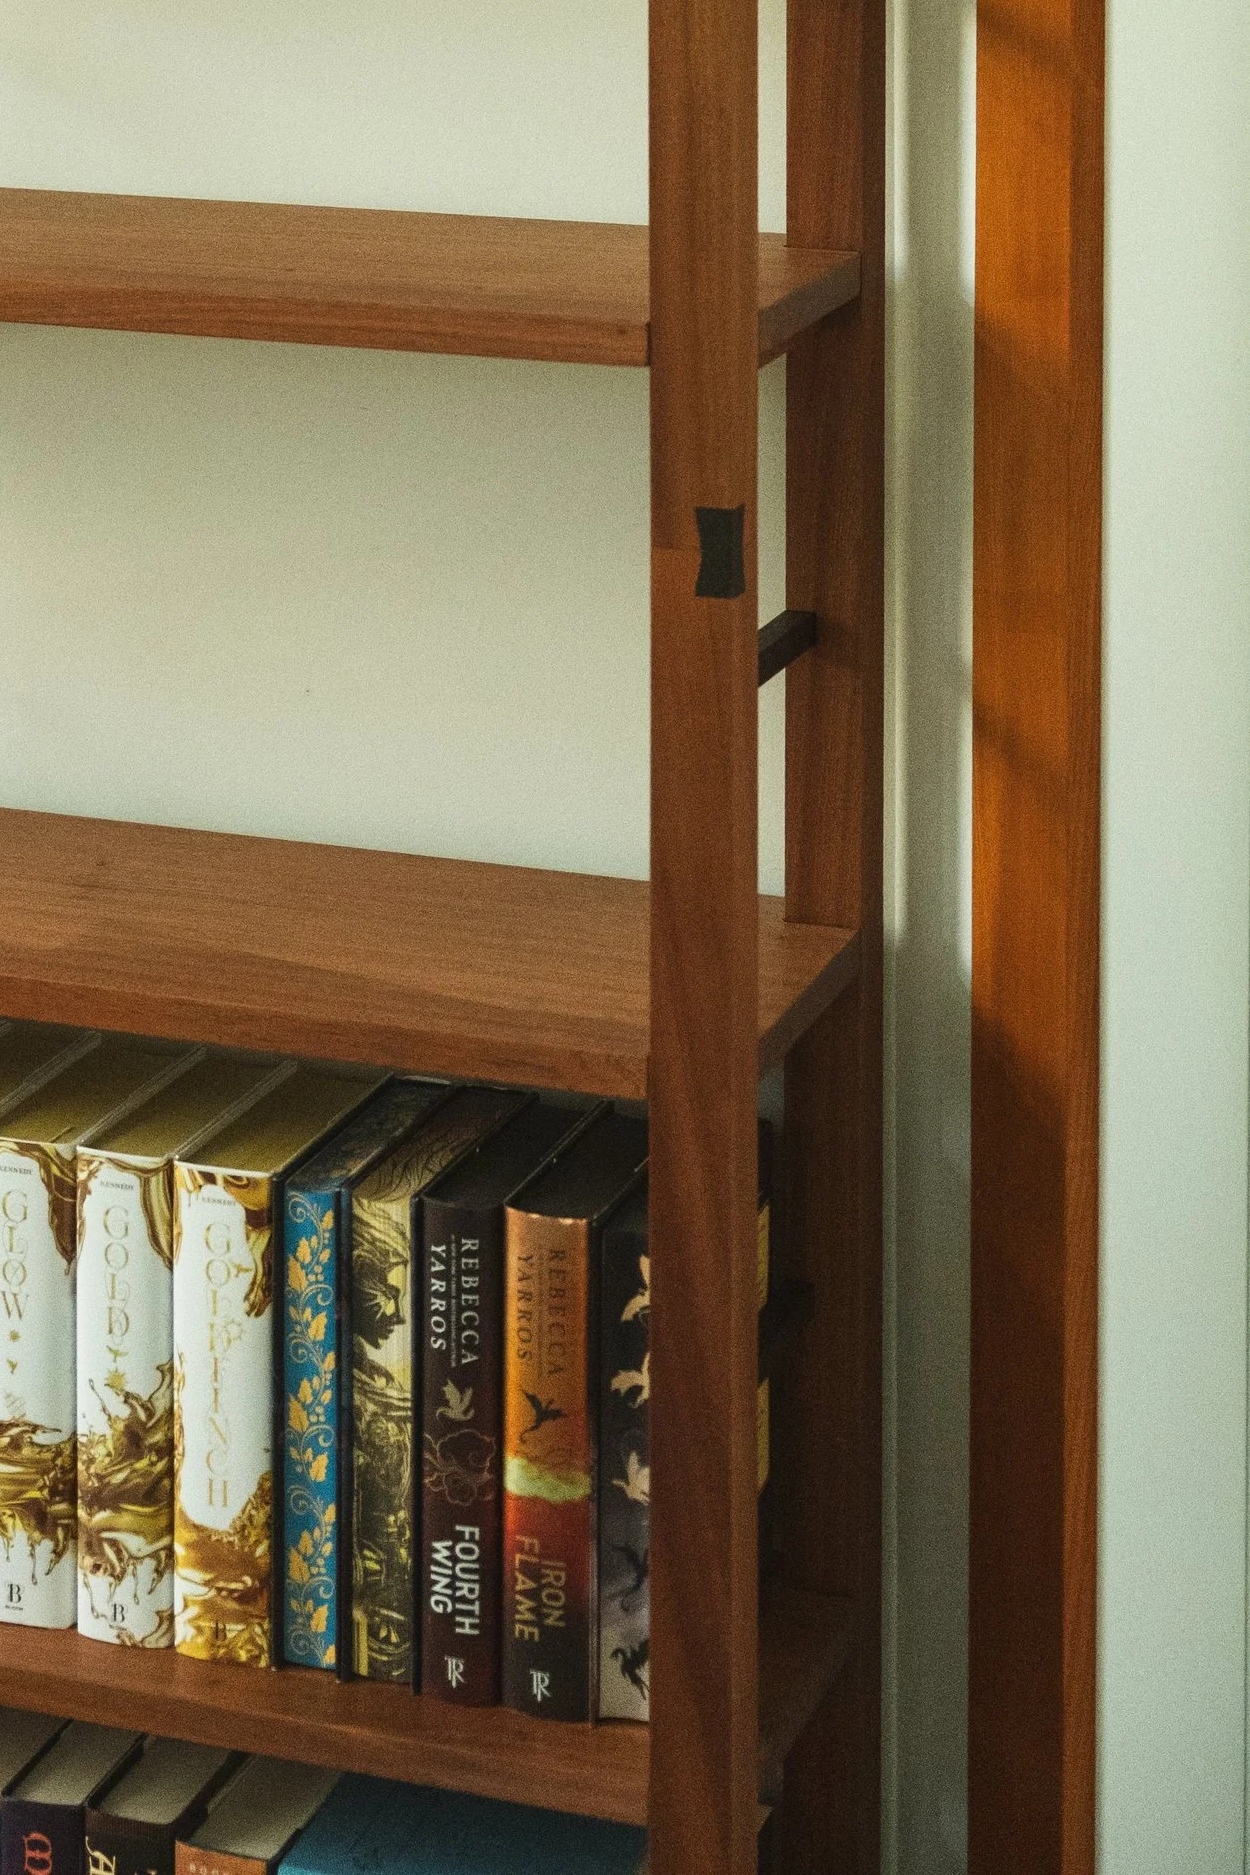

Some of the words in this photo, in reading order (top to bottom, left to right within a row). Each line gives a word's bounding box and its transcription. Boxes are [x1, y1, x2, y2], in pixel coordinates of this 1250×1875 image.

[0, 1189, 29, 1319] GLOW
[104, 1205, 131, 1337] GOLD
[430, 1244, 447, 1351] YARROS
[460, 1237, 479, 1365] REBECCA
[430, 1540, 453, 1615] WING
[455, 1525, 480, 1636] FOURTH
[514, 1535, 539, 1642] FLAME
[541, 1560, 566, 1628] IRON
